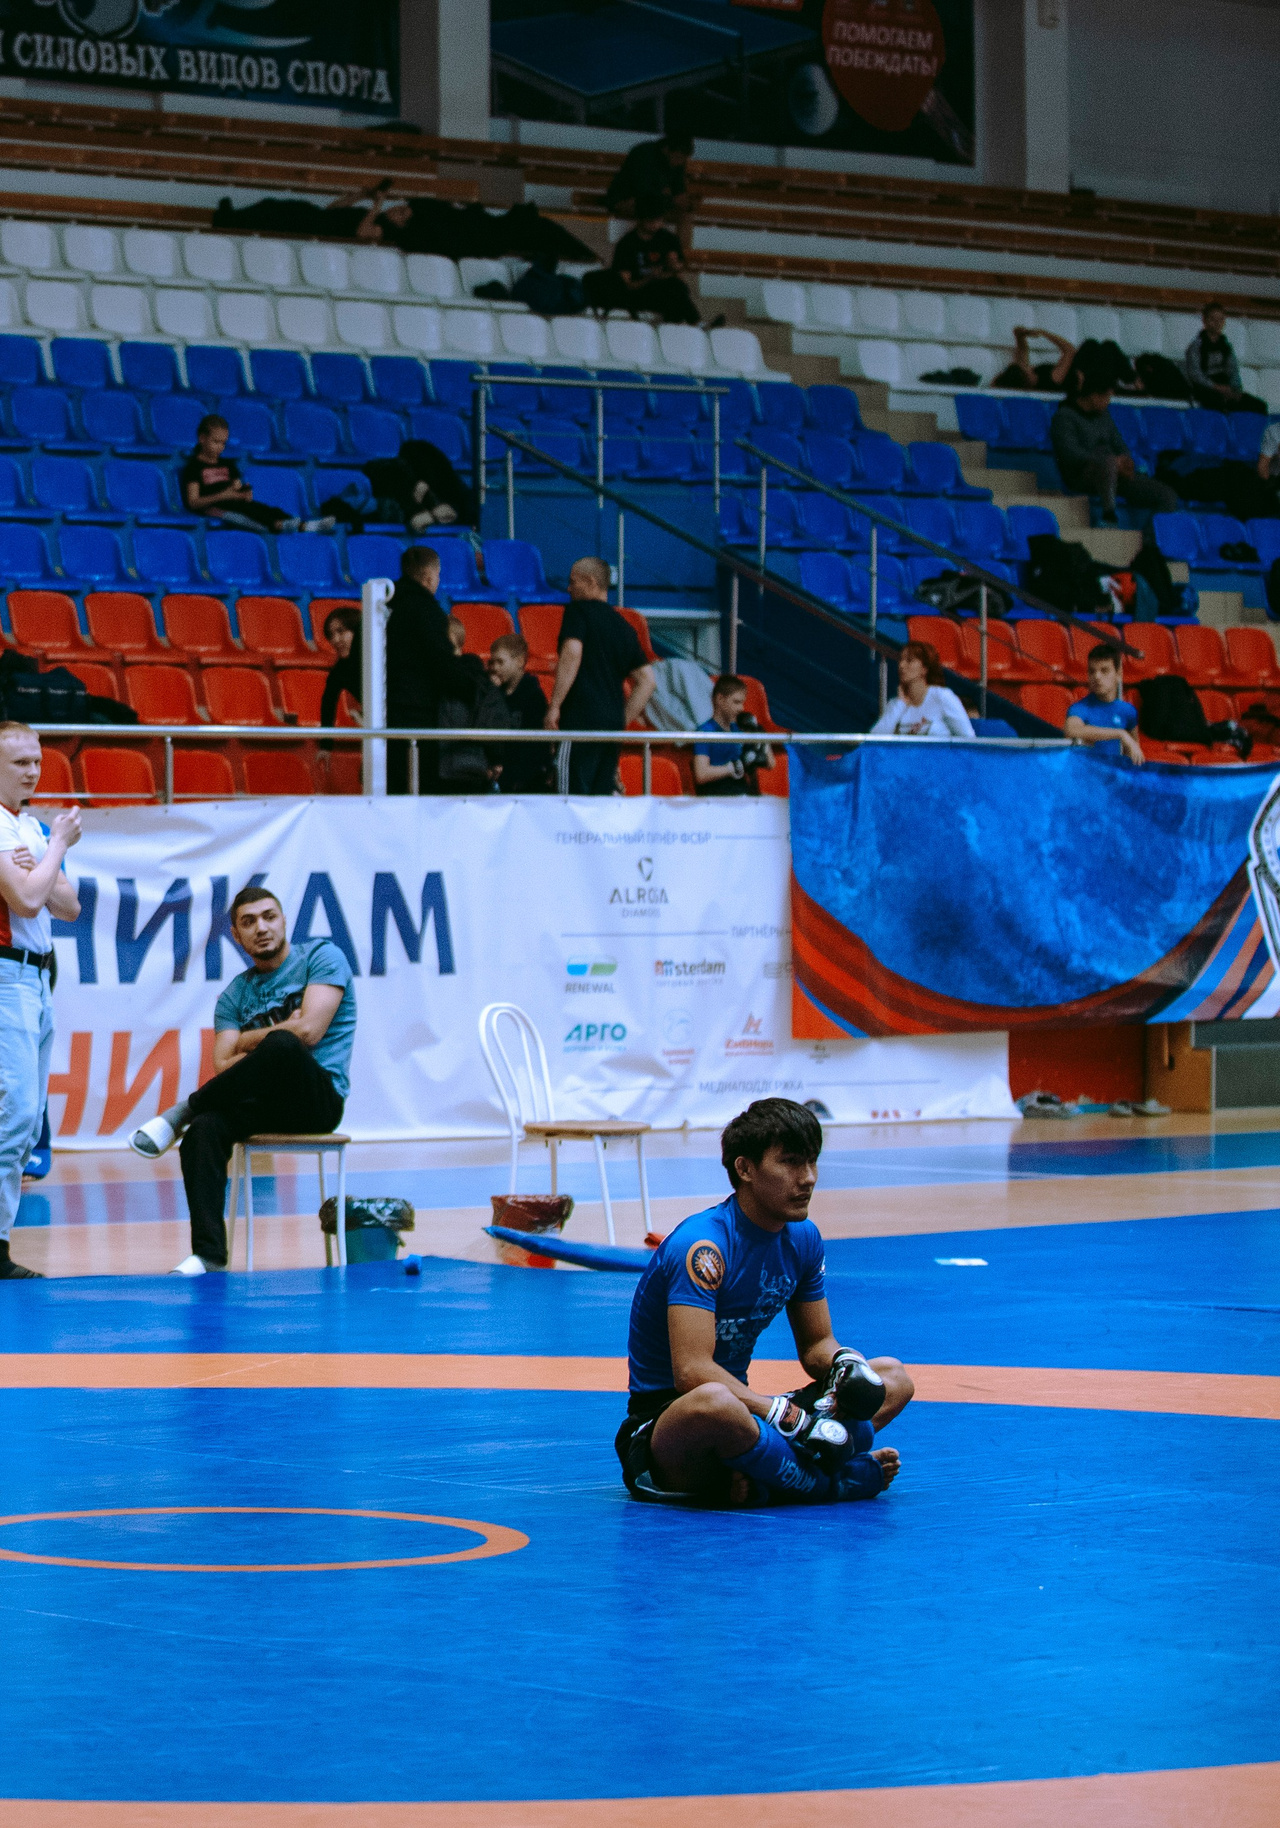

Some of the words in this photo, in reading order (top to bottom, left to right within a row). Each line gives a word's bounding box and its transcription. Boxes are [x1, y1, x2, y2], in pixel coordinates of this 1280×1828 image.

[832, 20, 933, 50] ПОМОГАЕМ
[13, 33, 169, 80] СИЛОВЫХ
[178, 49, 281, 91] ВИДОВ
[563, 1022, 628, 1043] АРГО
[775, 1456, 817, 1493] VENUM
